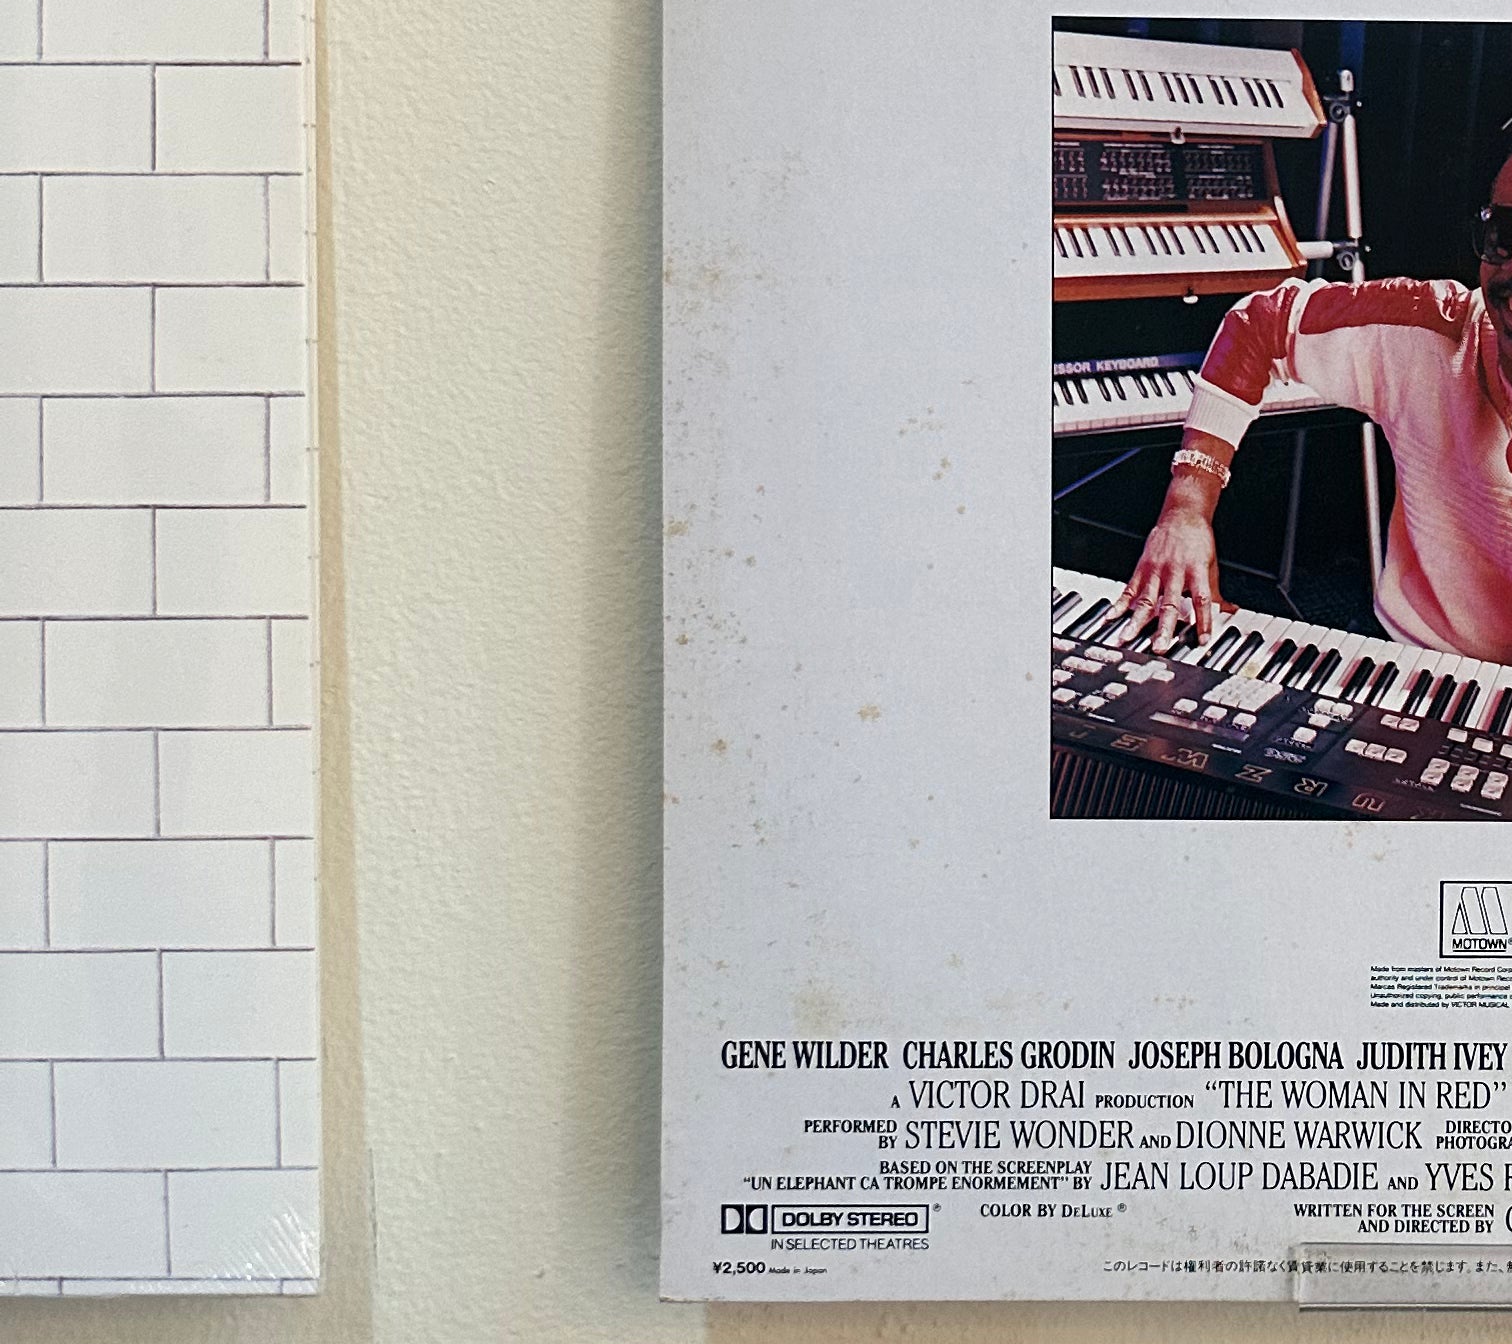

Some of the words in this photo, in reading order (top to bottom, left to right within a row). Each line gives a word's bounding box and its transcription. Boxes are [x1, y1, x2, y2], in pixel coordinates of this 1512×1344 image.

[1452, 938, 1507, 950] MOTOWN
[722, 1041, 786, 1069] GENE
[792, 1041, 889, 1068] WILDER
[903, 1041, 1013, 1069] CHARLES
[1021, 1041, 1115, 1069] GRODIN
[1129, 1041, 1221, 1069] JOSEPH
[1229, 1042, 1344, 1069] BOLOGNA
[1357, 1042, 1446, 1070] JUDITH
[1454, 1043, 1508, 1070] IVEY
[891, 1096, 900, 1108] A
[909, 1080, 1010, 1108] VICTOR
[1021, 1080, 1084, 1108] DRAI
[1096, 1095, 1193, 1108] PRODUCTION
[1206, 1081, 1272, 1108] "THE
[1281, 1081, 1387, 1108] WOMAN
[1399, 1081, 1425, 1108] IN
[1437, 1082, 1506, 1109] RED"
[906, 1121, 1000, 1149] STEVIE
[1010, 1120, 1134, 1148] WONDER
[1139, 1136, 1171, 1148] AND
[1177, 1121, 1285, 1148] DIONNE
[1294, 1121, 1422, 1149] WARWICK
[1101, 1162, 1168, 1190] JEAN
[1180, 1162, 1253, 1190] LOUP
[1263, 1162, 1378, 1190] DABADIE
[1388, 1177, 1418, 1190] AND
[1425, 1163, 1493, 1191] YVES
[783, 1212, 843, 1226] DOLBY
[848, 1212, 918, 1226] STEREO
[713, 1262, 765, 1275] ¥2,500
